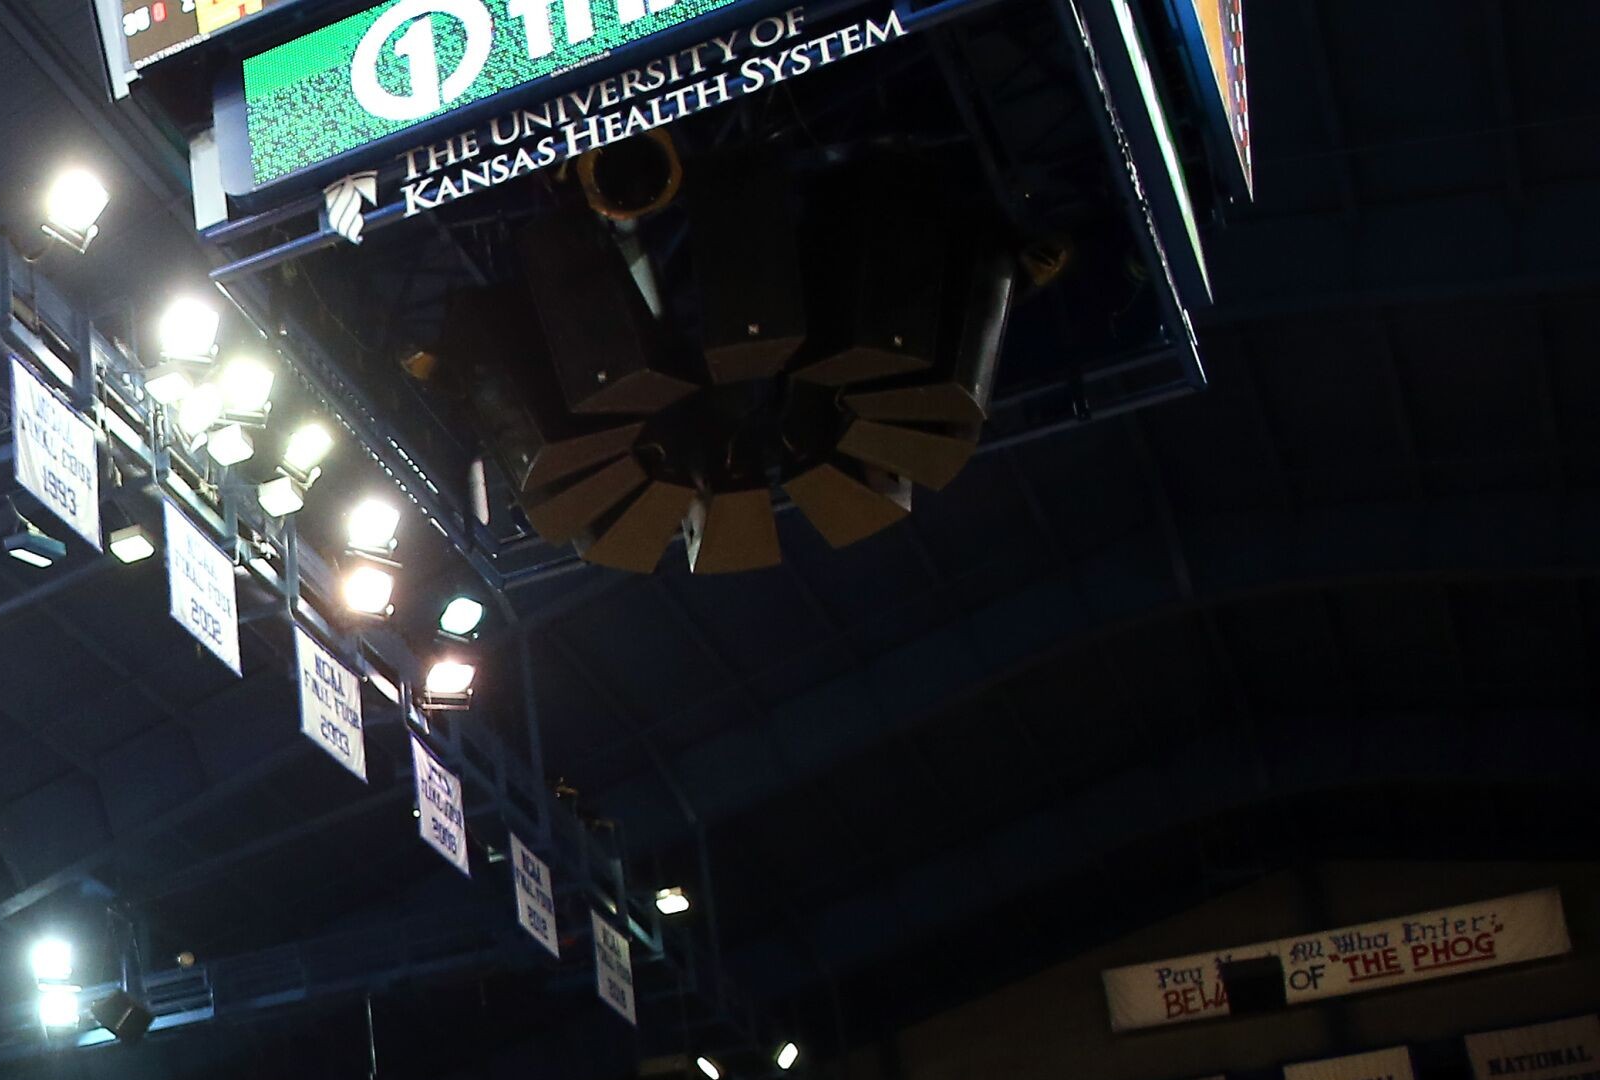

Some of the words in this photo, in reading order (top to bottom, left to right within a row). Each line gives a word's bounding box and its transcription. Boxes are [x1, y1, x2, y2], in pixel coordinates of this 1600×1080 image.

[397, 129, 480, 182] THE
[489, 30, 740, 146] UNIVERSITY
[750, 6, 806, 48] OF
[401, 137, 556, 219] KANSAS
[561, 72, 732, 159] HEALTH
[741, 9, 909, 94] SYSTEM
[1289, 964, 1326, 992] OF
[1488, 1046, 1593, 1076] NATIONAL
